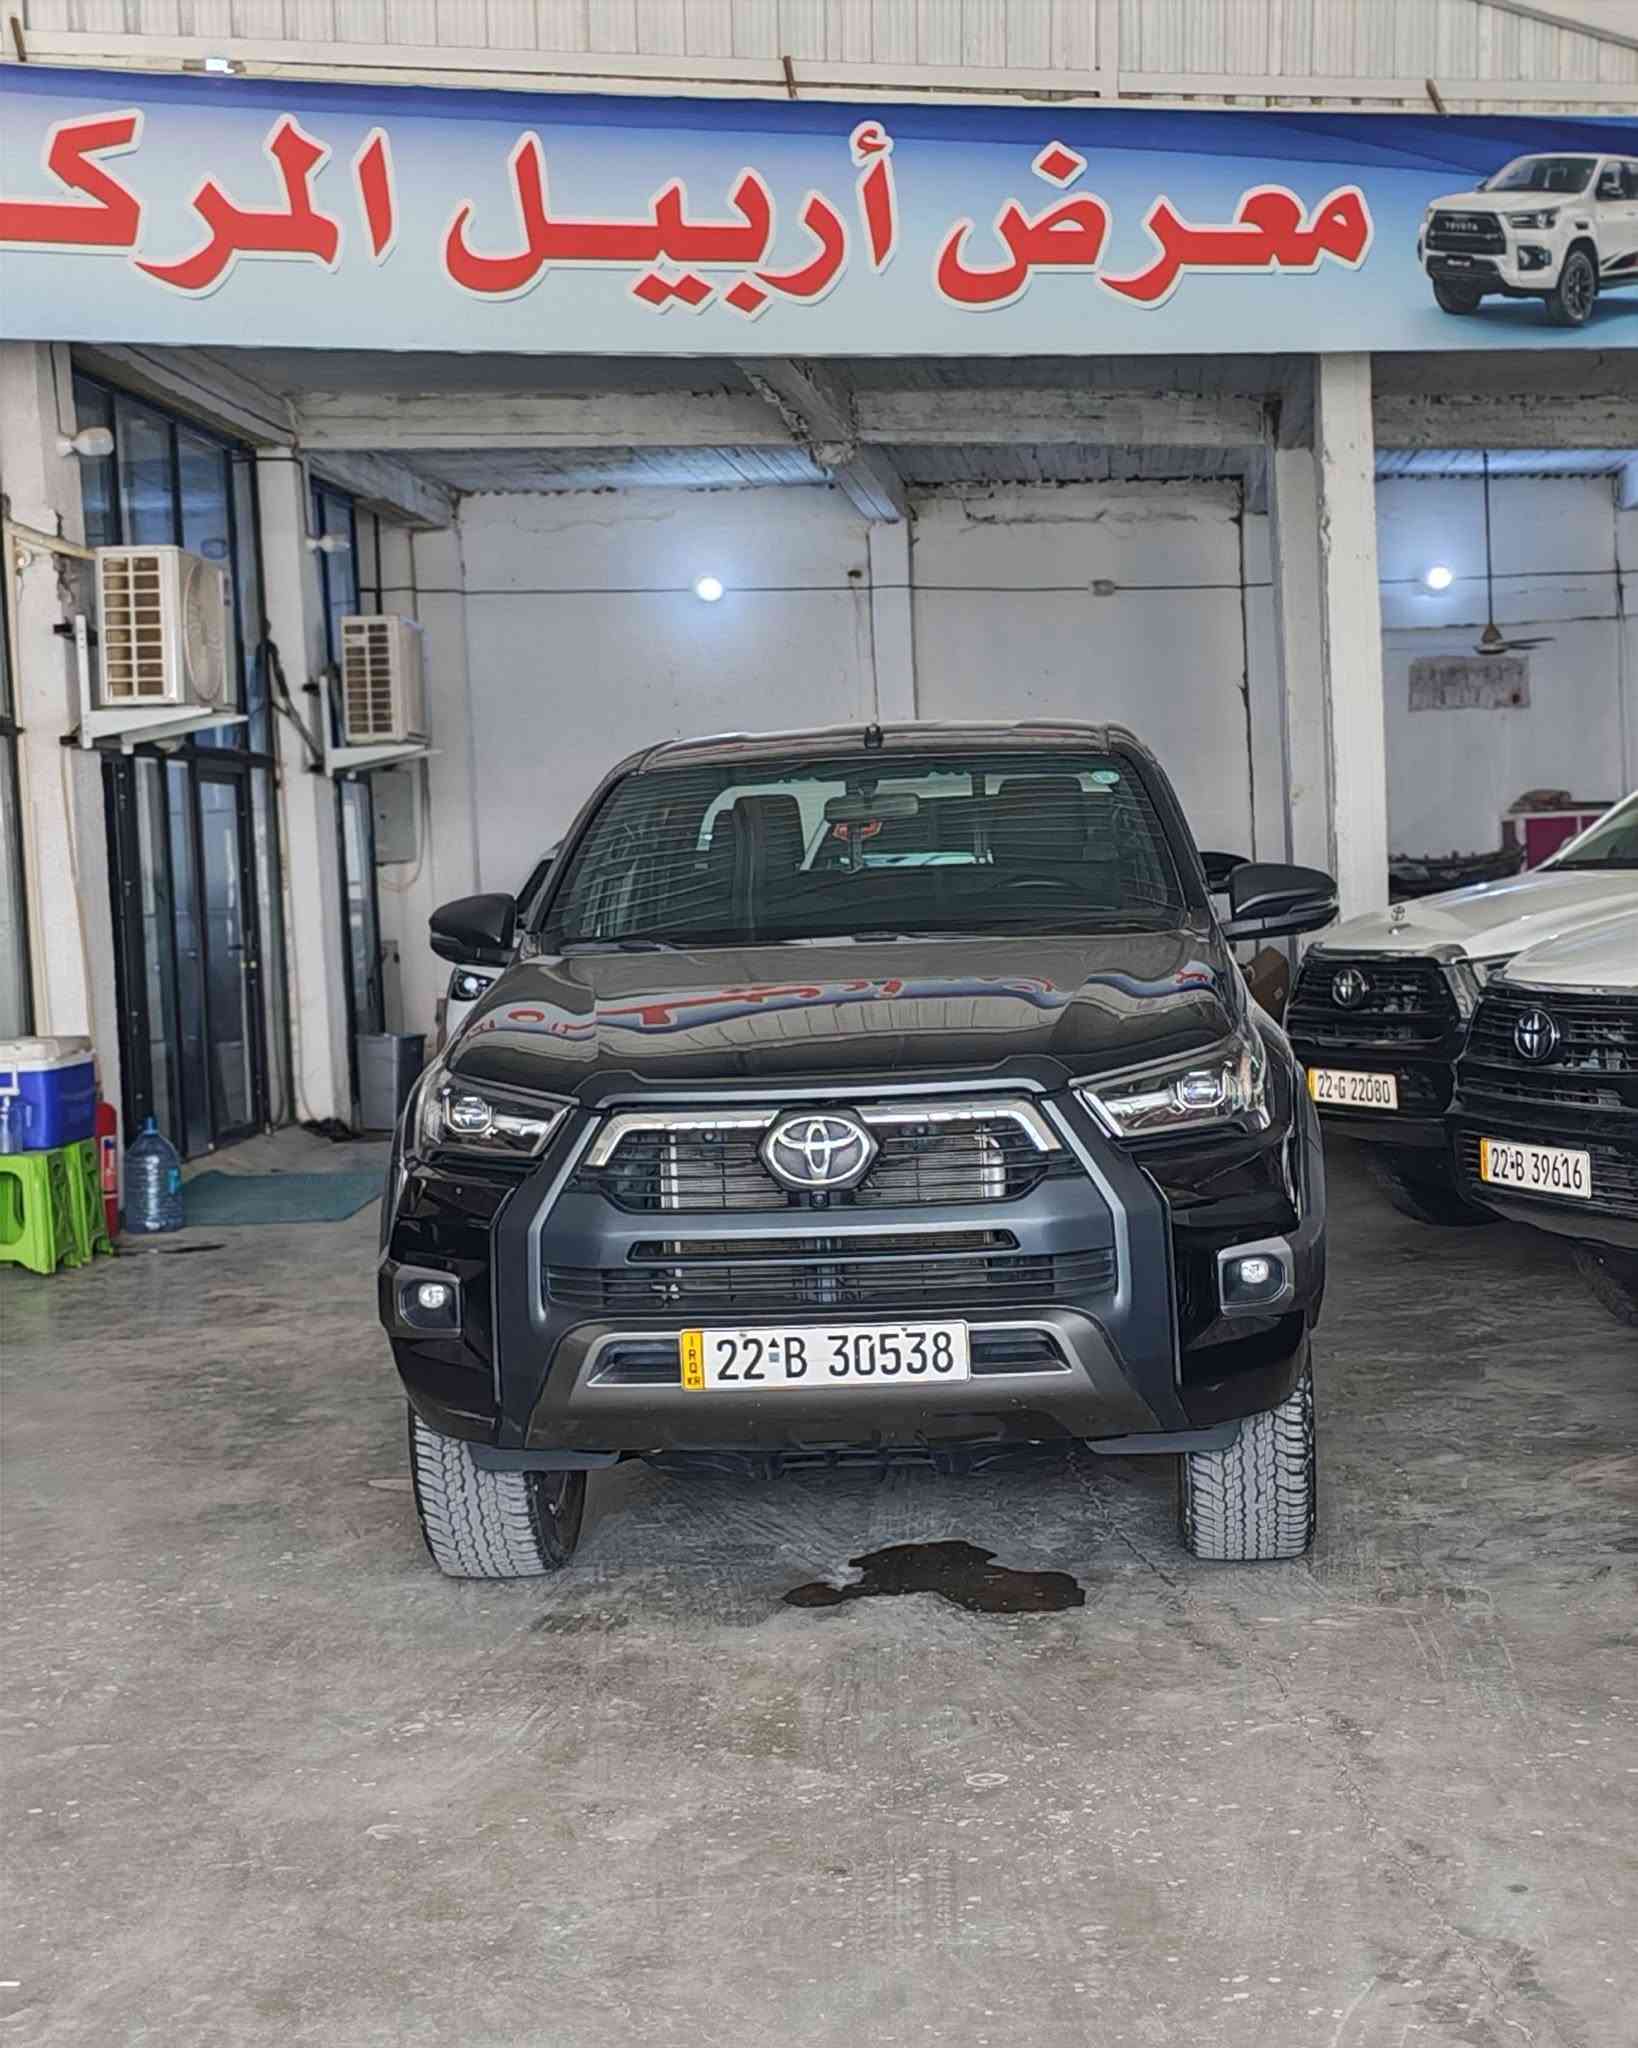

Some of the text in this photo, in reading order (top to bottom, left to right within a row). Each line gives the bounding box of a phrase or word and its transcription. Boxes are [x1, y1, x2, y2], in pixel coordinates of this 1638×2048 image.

[0, 118, 1368, 313] معرض أربيل المرك
[1318, 1075, 1332, 1098] 22
[1351, 1077, 1391, 1103] 22080
[1491, 1148, 1583, 1189] 22 B 39616
[716, 1331, 954, 1380] 22 B 30538
